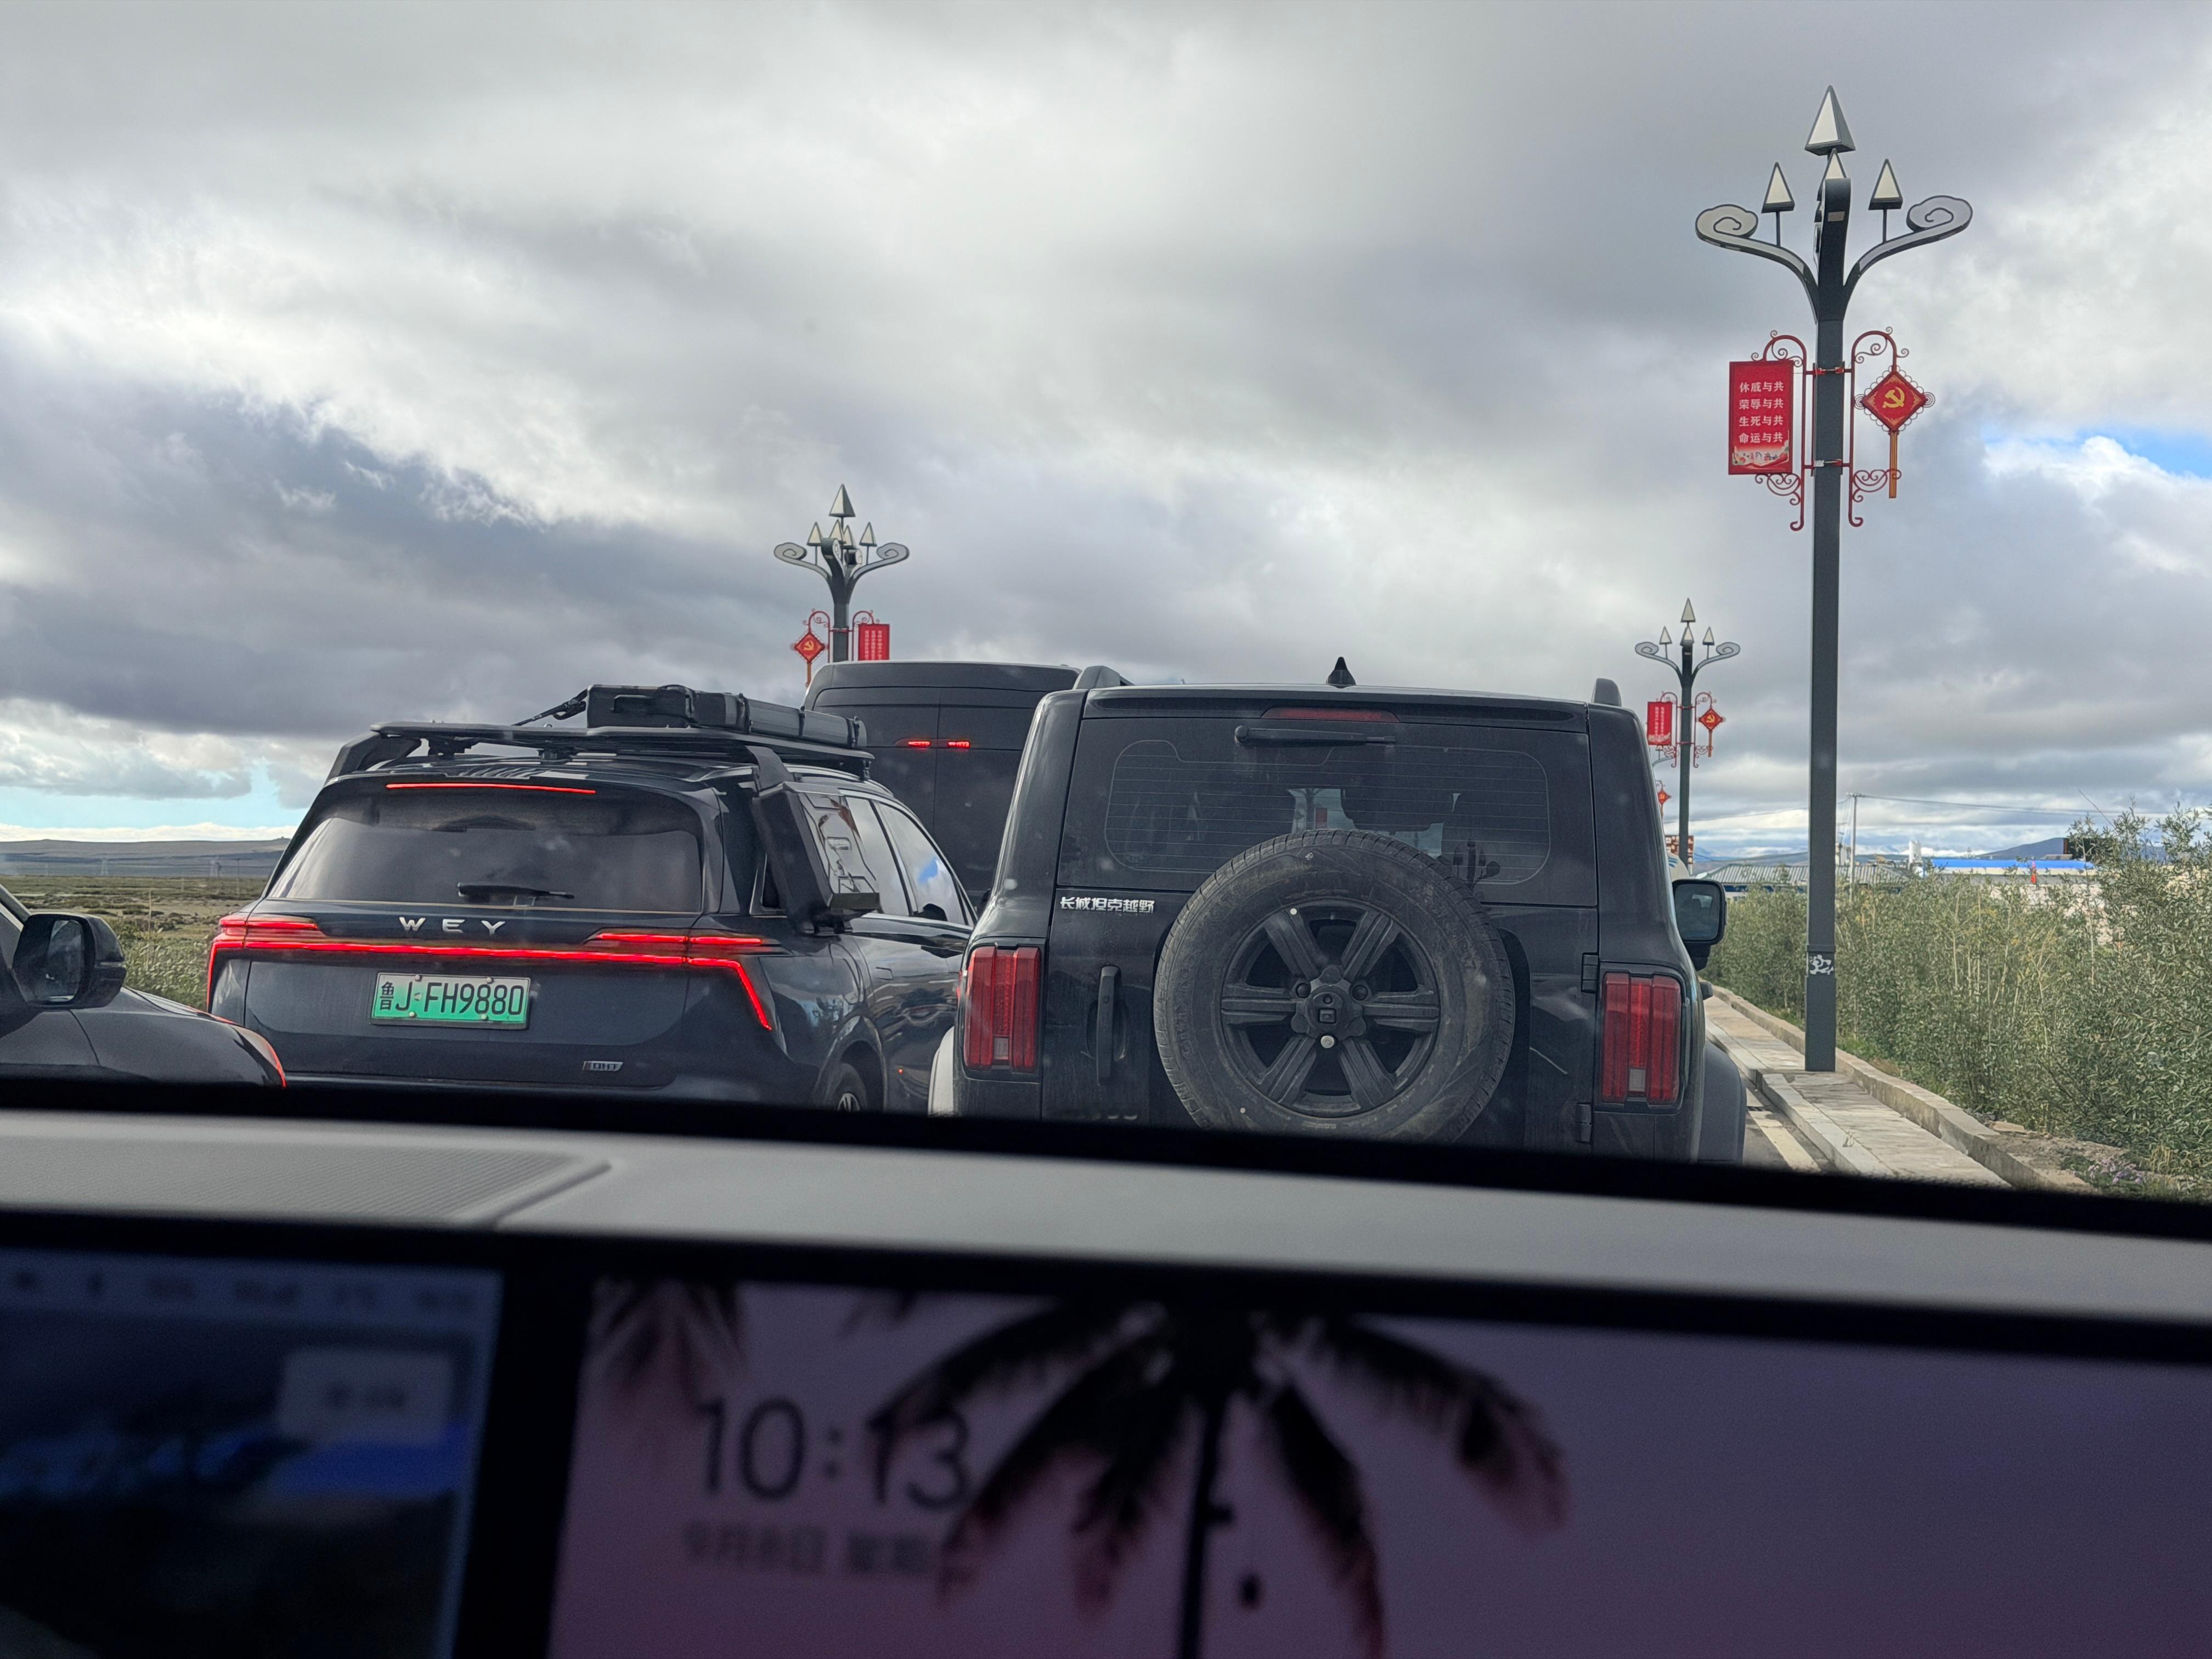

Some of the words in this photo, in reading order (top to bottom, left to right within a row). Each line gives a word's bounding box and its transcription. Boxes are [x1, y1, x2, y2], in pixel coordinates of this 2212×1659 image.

[1739, 381, 1784, 393] 休戚与共
[1739, 398, 1784, 409] 荣辱与共
[1739, 415, 1784, 427] 生死与共
[1738, 432, 1784, 444] 命运与共
[1060, 896, 1155, 913] 长城坦克越野
[399, 917, 506, 936] WEY
[696, 1396, 970, 1511] 10:13
